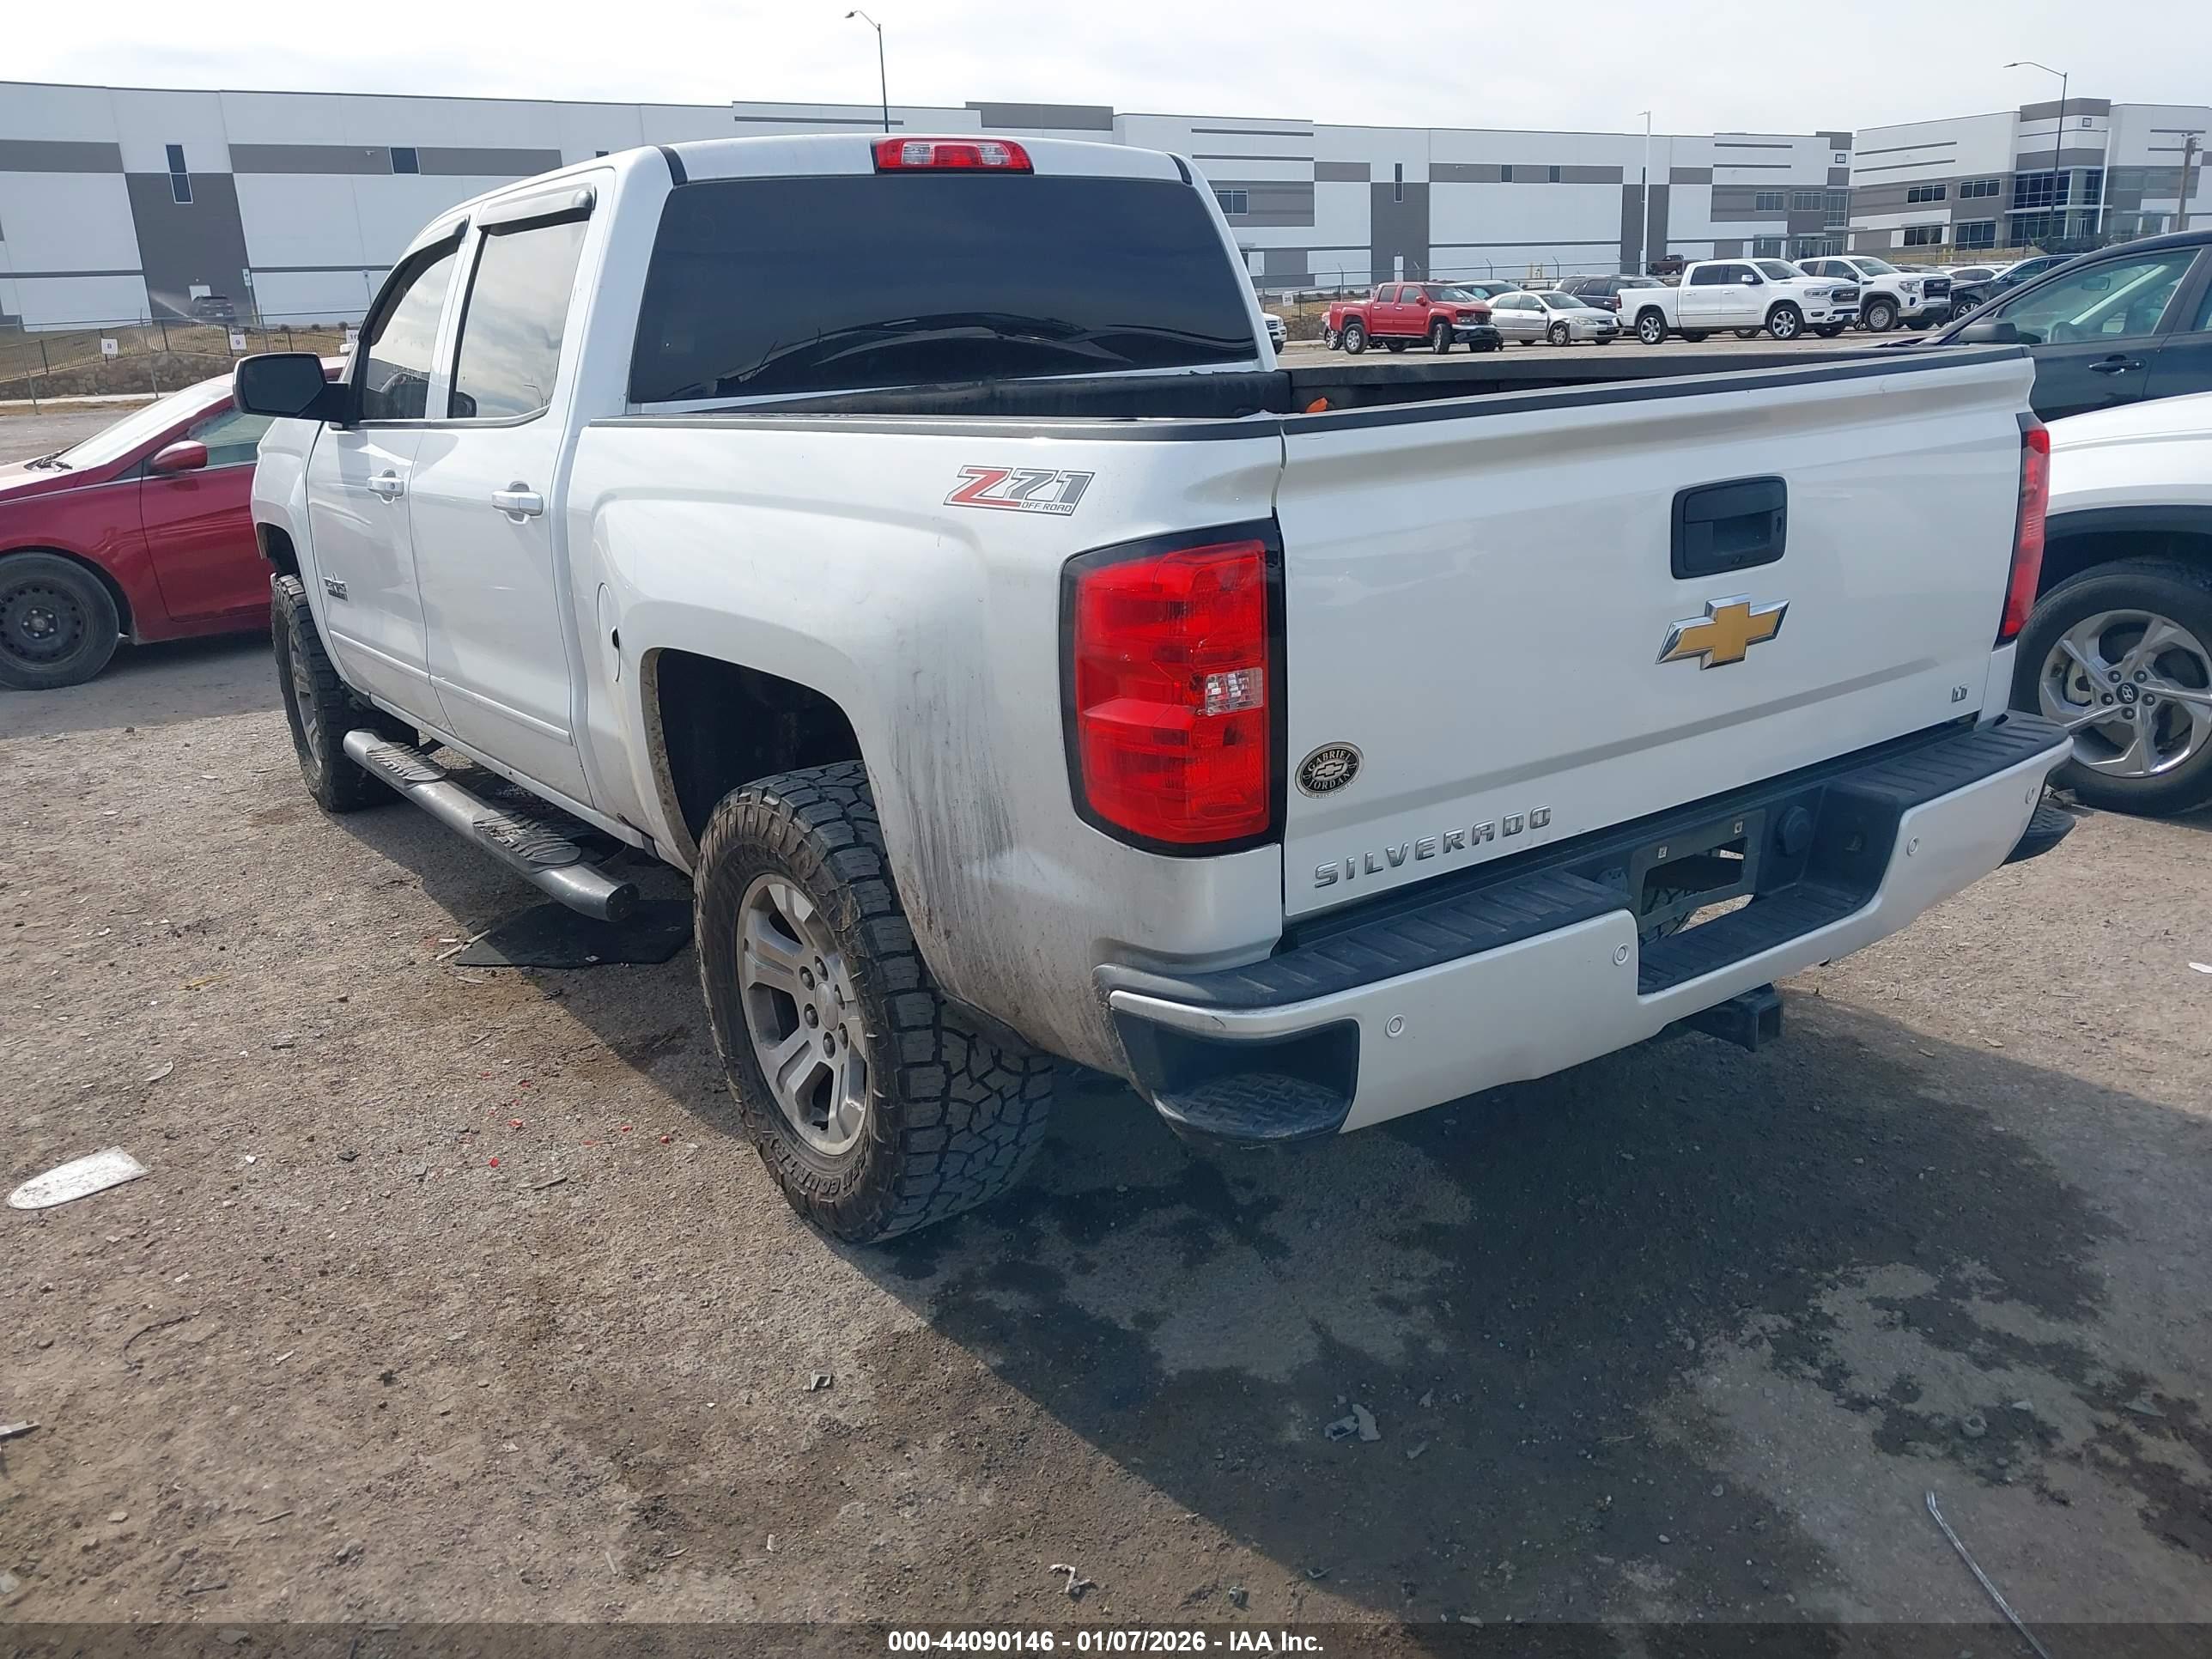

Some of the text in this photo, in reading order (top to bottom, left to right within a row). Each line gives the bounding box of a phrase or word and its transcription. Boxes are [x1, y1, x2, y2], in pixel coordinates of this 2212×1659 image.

[946, 466, 1092, 507] Z71
[1043, 503, 1073, 513] ROAD
[1307, 750, 1352, 772] GABRIEL
[1308, 772, 1351, 790] JORDAN
[1314, 805, 1553, 889] SILVERADO
